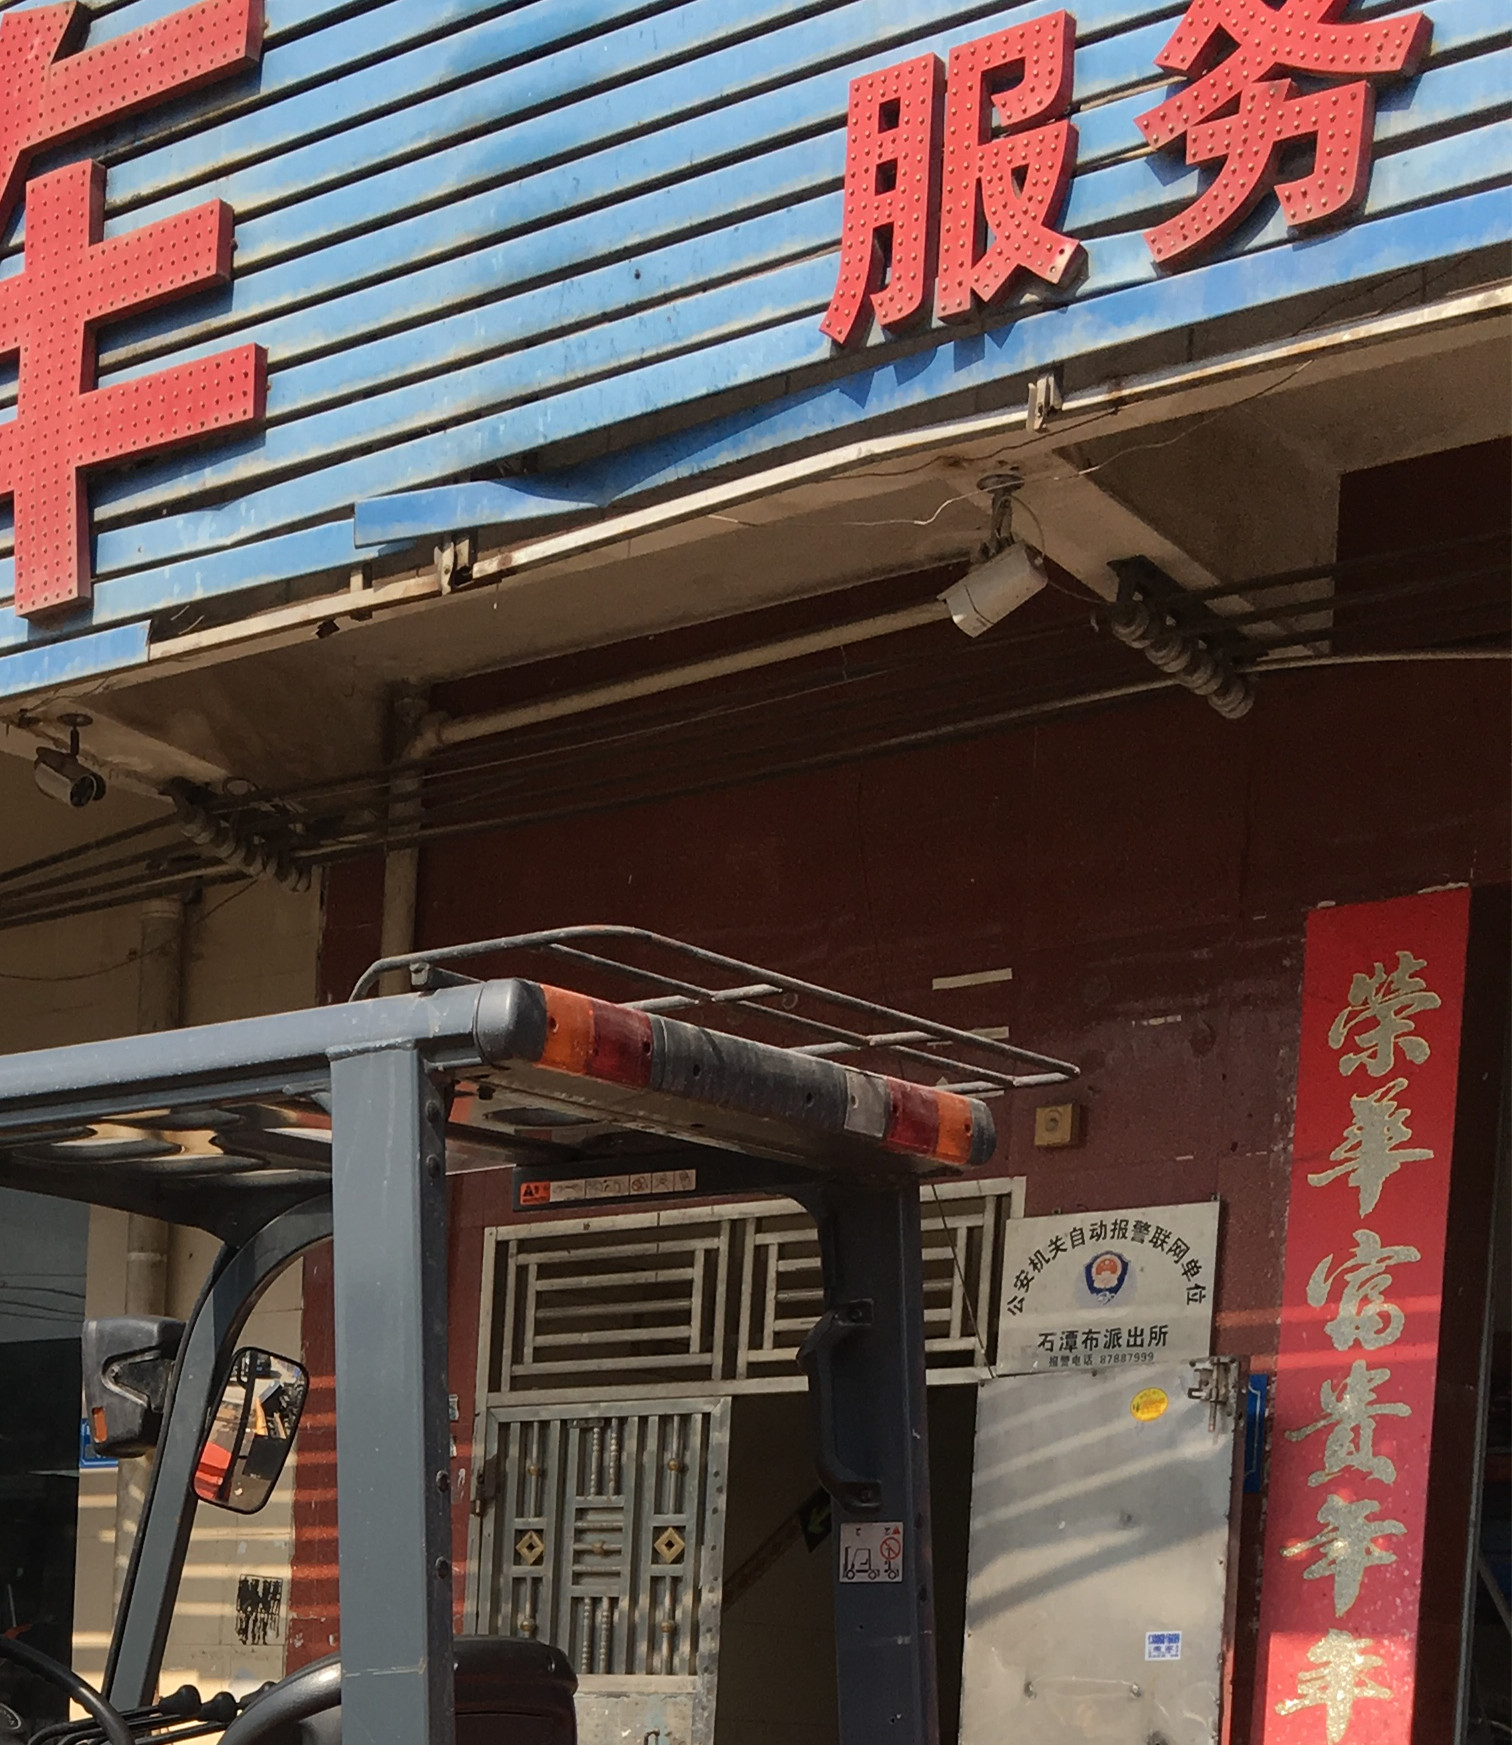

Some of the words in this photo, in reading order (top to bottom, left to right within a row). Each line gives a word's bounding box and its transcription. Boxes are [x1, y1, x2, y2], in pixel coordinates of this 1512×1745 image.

[1006, 1218, 1207, 1317] 公安机关自动报警联网单位
[1038, 1324, 1170, 1353] 石潭布派出所
